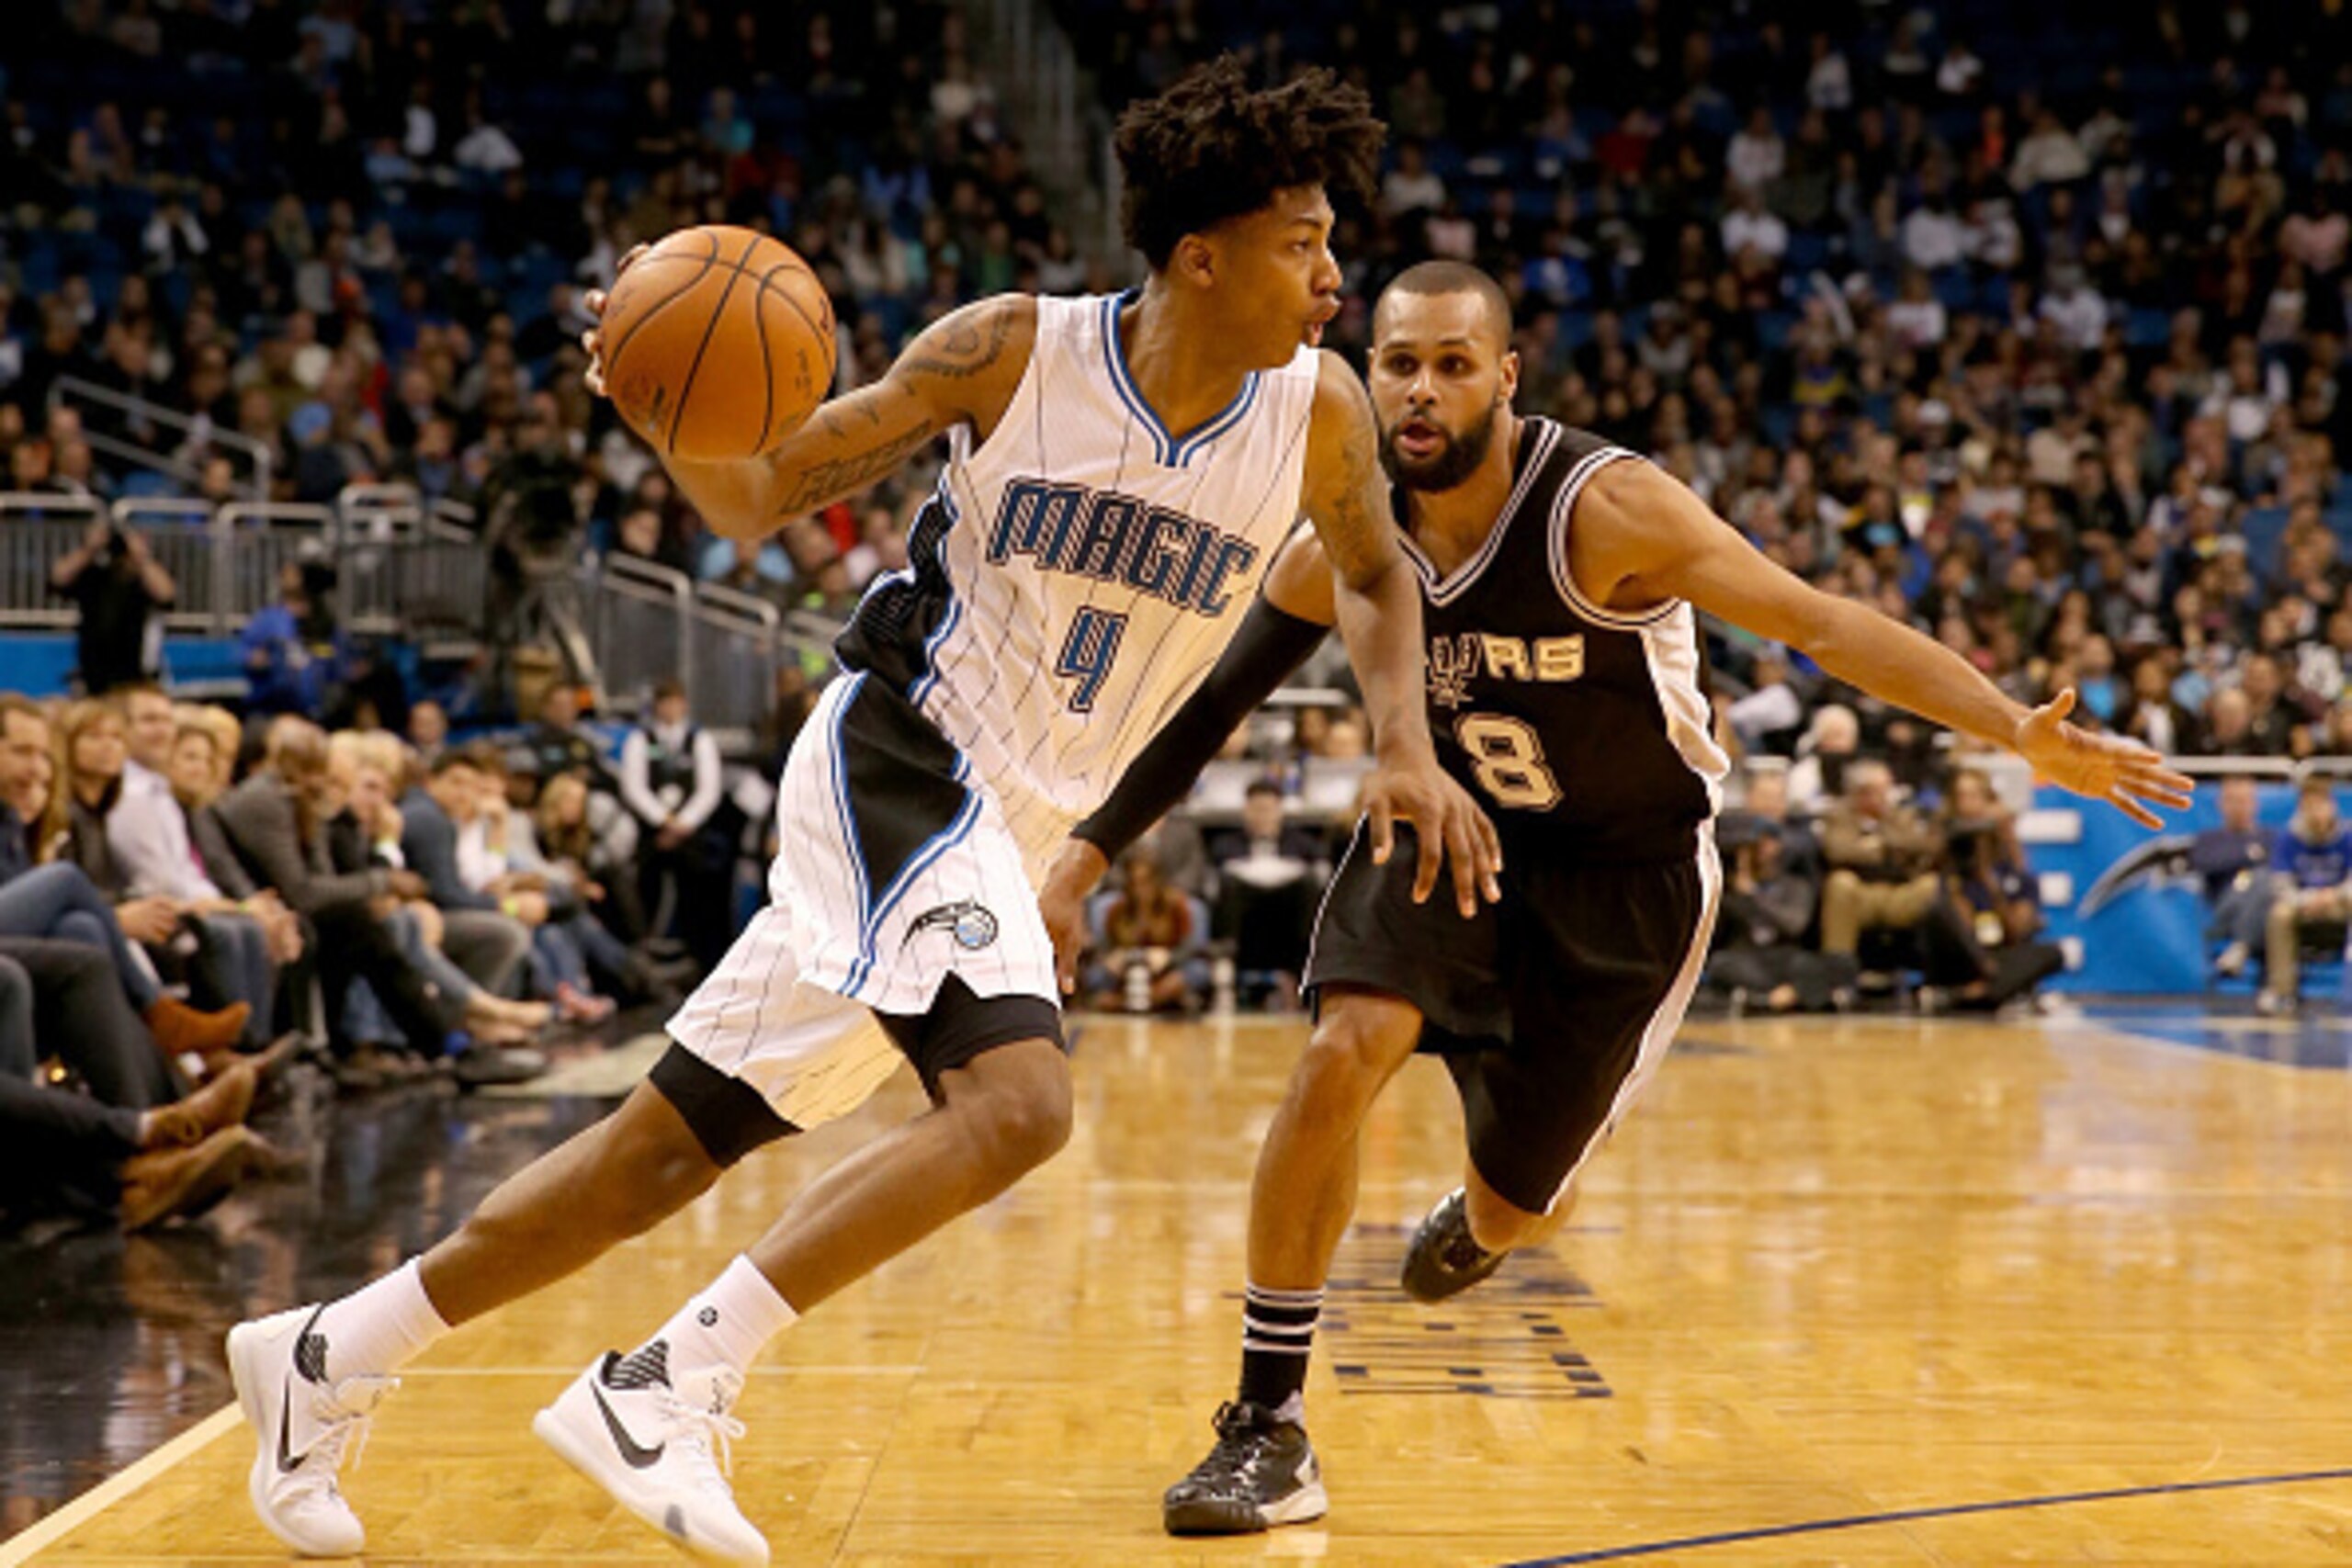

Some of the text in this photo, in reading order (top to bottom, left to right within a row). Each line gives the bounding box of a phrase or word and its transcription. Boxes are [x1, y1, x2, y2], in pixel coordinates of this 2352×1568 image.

[986, 476, 1260, 617] MAGIC
[1053, 604, 1129, 714] 4
[1427, 631, 1585, 696] URS
[1452, 712, 1564, 812] 8
